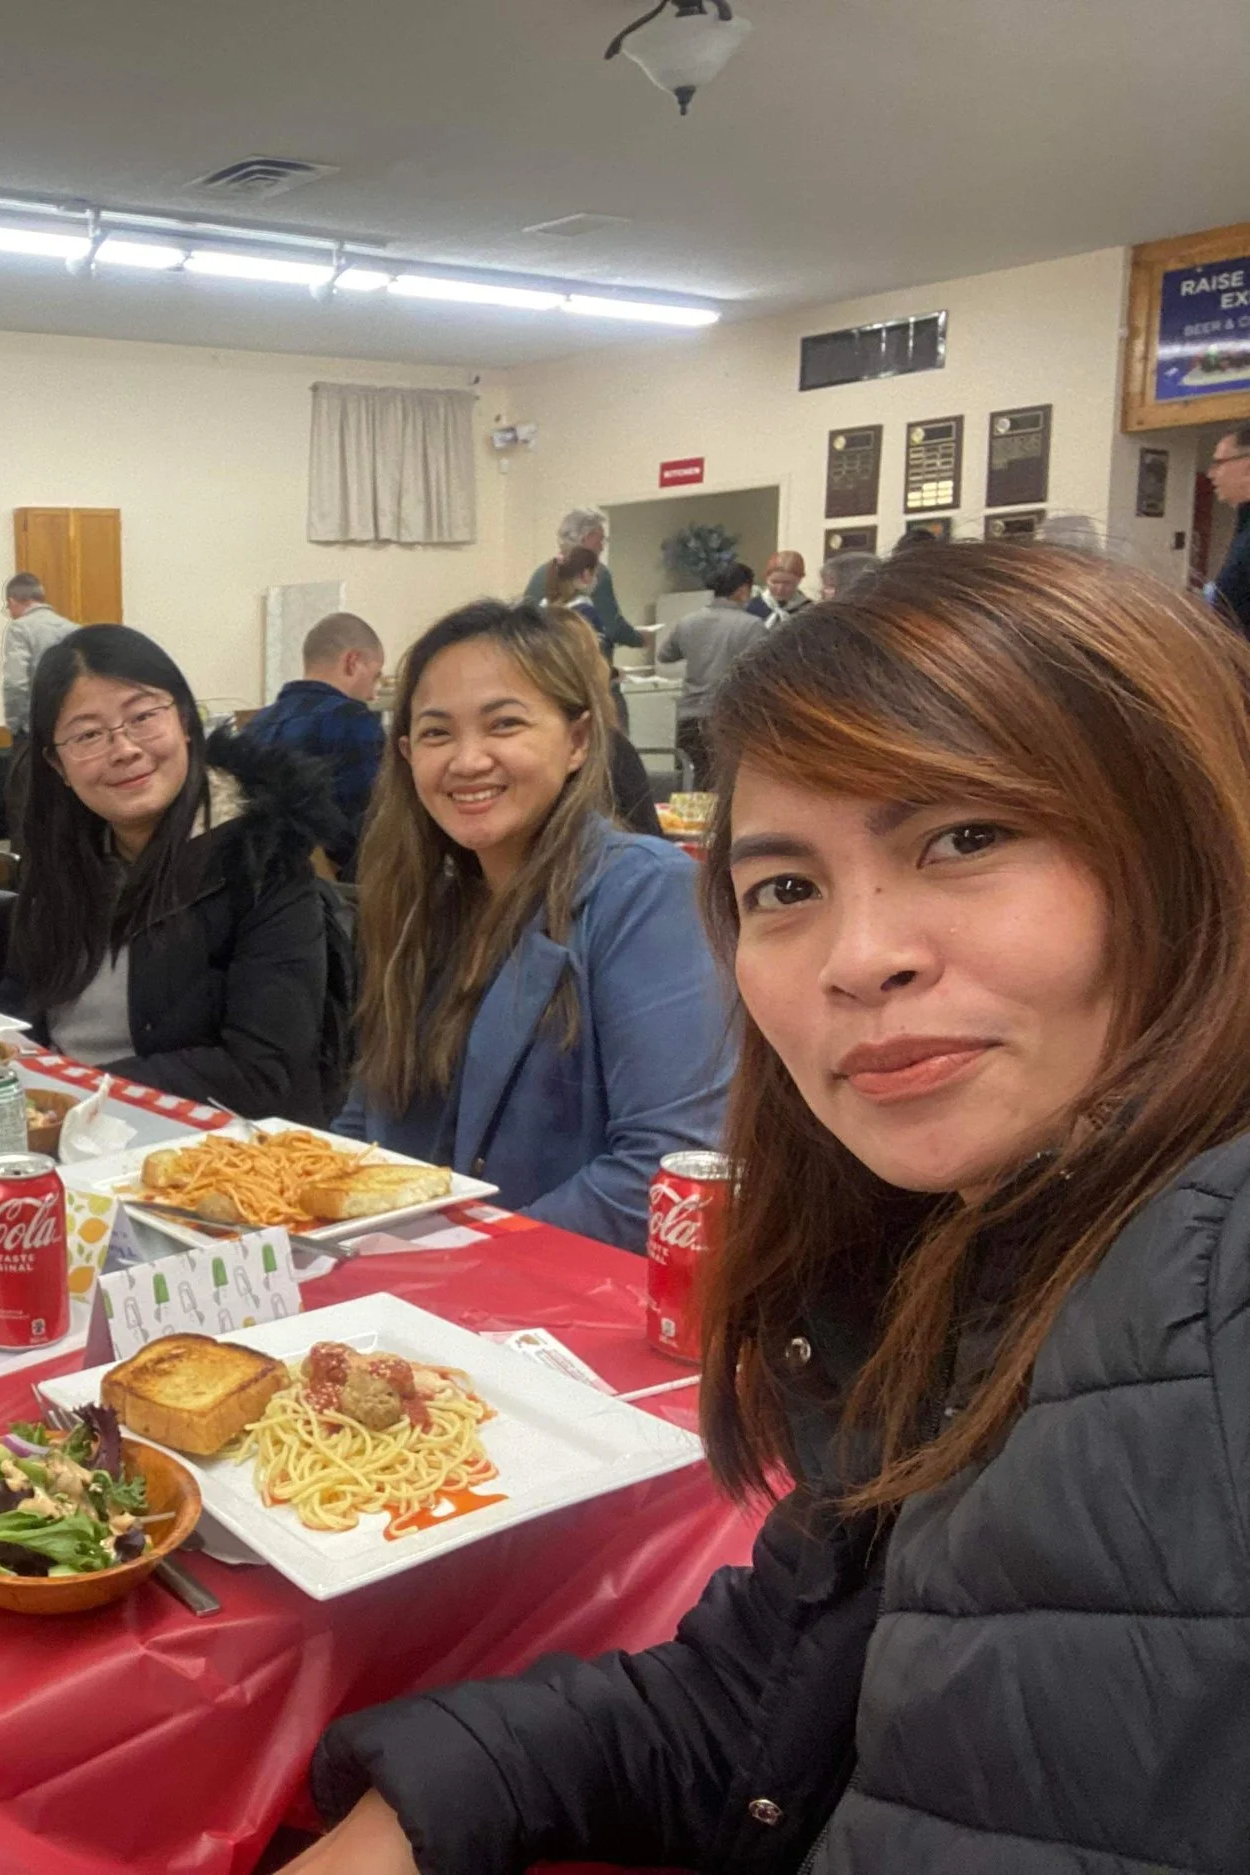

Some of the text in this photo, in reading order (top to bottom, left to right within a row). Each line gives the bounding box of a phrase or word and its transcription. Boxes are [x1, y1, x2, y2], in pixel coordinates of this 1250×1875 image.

[1180, 270, 1244, 296] RAISE
[1184, 320, 1222, 337] BEER
[1224, 318, 1235, 330] &
